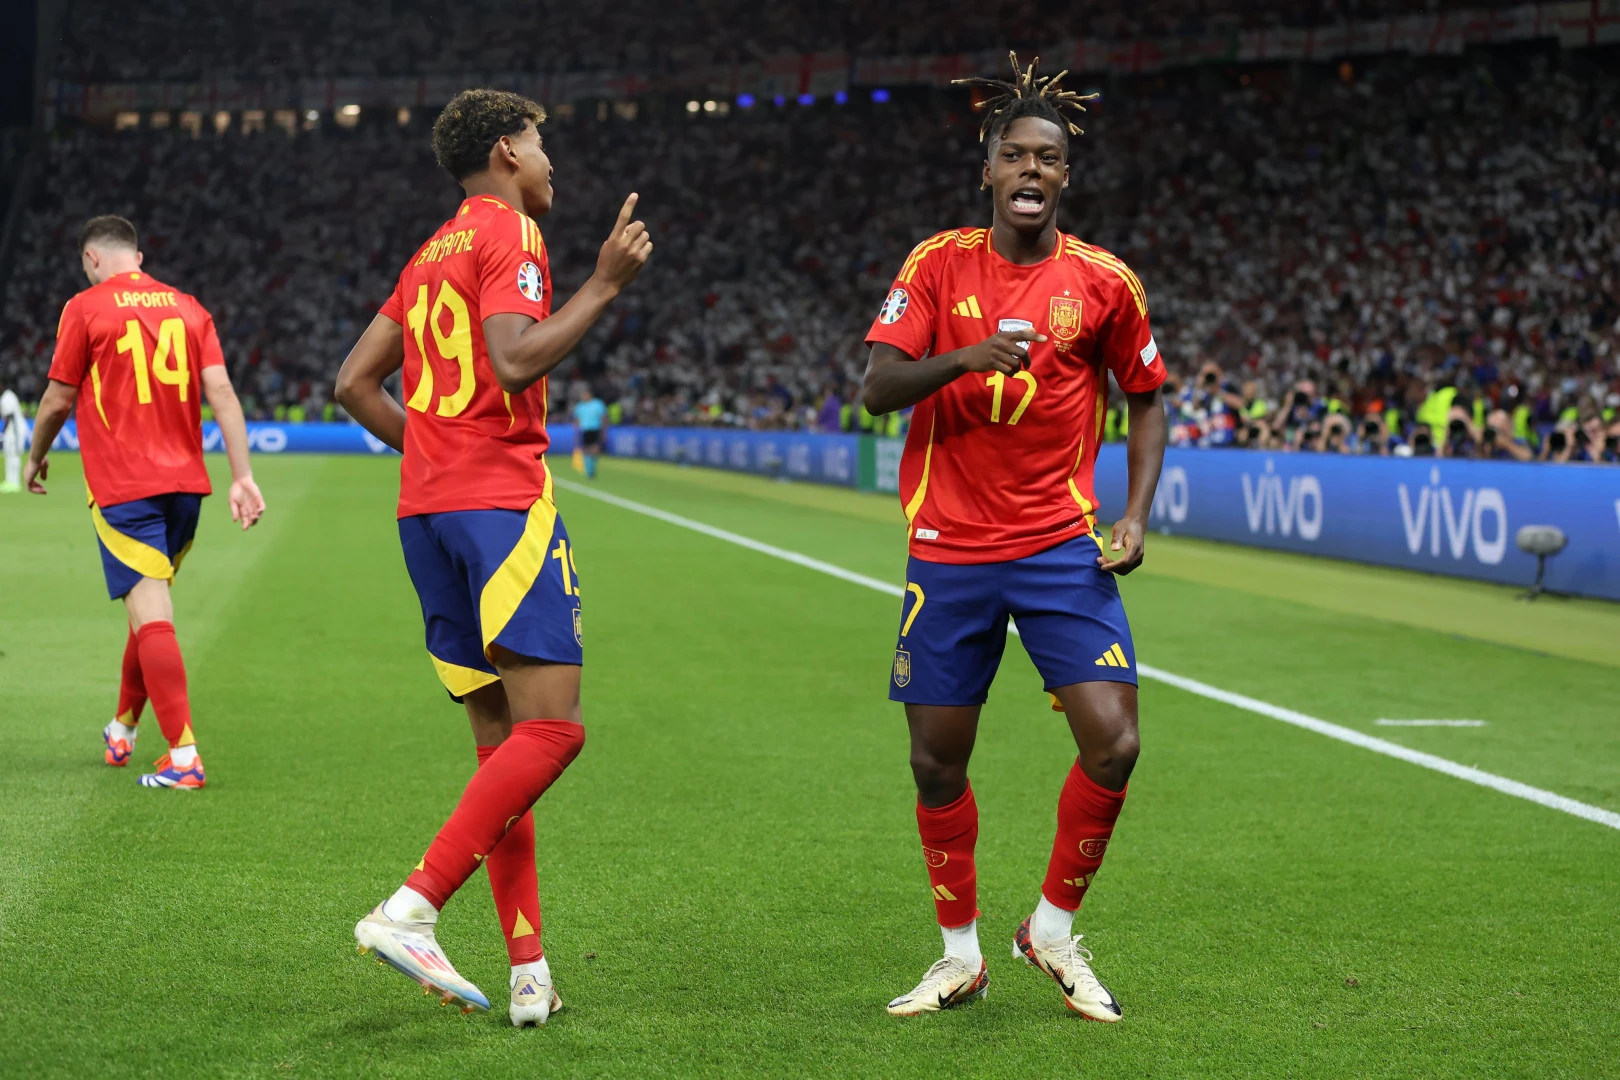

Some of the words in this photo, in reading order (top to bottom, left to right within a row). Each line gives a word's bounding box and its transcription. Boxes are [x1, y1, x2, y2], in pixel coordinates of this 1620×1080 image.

[114, 291, 178, 308] LAPORTE
[116, 317, 190, 404] 14
[406, 279, 476, 417] 19
[985, 370, 1037, 425] 17
